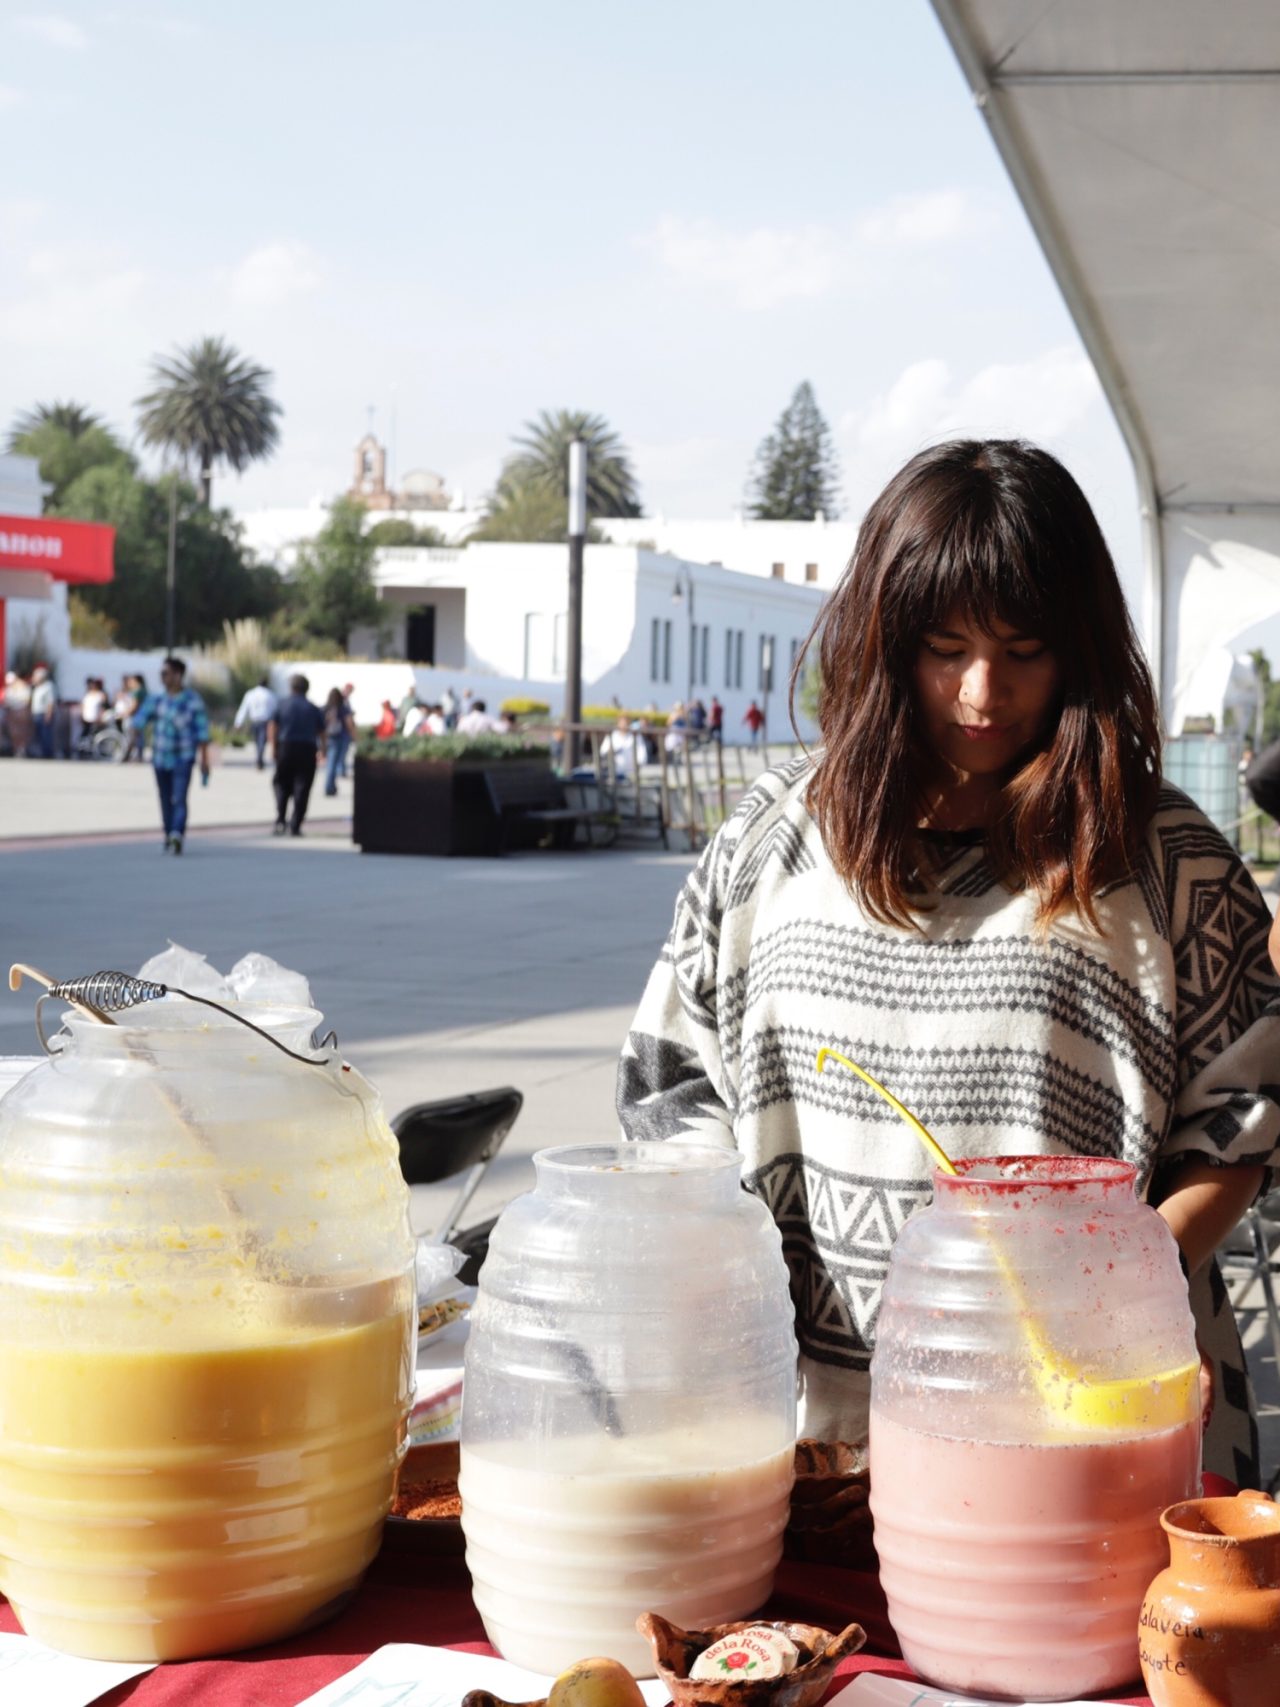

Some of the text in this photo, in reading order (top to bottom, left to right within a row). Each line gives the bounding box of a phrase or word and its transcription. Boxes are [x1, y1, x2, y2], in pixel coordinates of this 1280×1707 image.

[705, 1638, 771, 1662] de la Rosa
